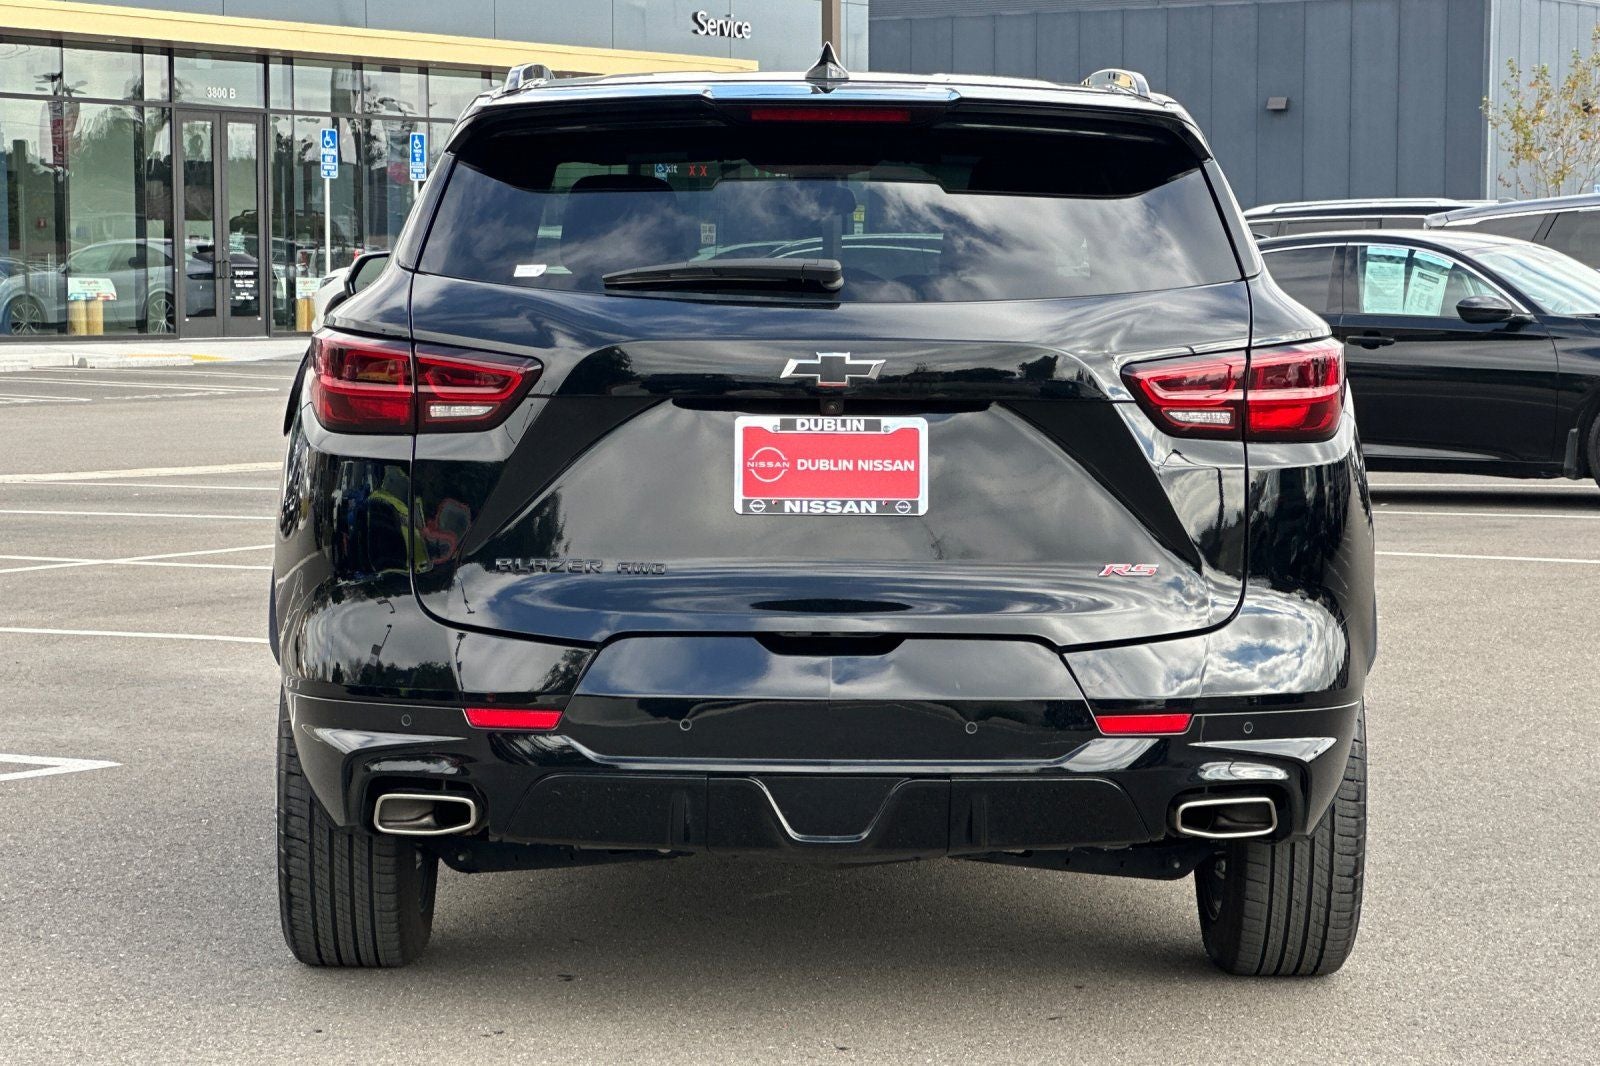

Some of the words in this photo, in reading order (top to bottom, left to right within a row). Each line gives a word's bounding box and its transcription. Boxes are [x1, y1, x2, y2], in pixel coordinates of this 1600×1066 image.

[696, 9, 752, 39] Service
[206, 86, 227, 99] 3800
[229, 87, 236, 99] B
[796, 418, 865, 432] DUBLIN
[797, 458, 854, 471] DUBLIN
[858, 459, 915, 472] NISSAN
[784, 500, 877, 514] NISSAN
[495, 558, 603, 573] BLAZER
[616, 562, 667, 575] AWD
[1098, 563, 1160, 577] RS
